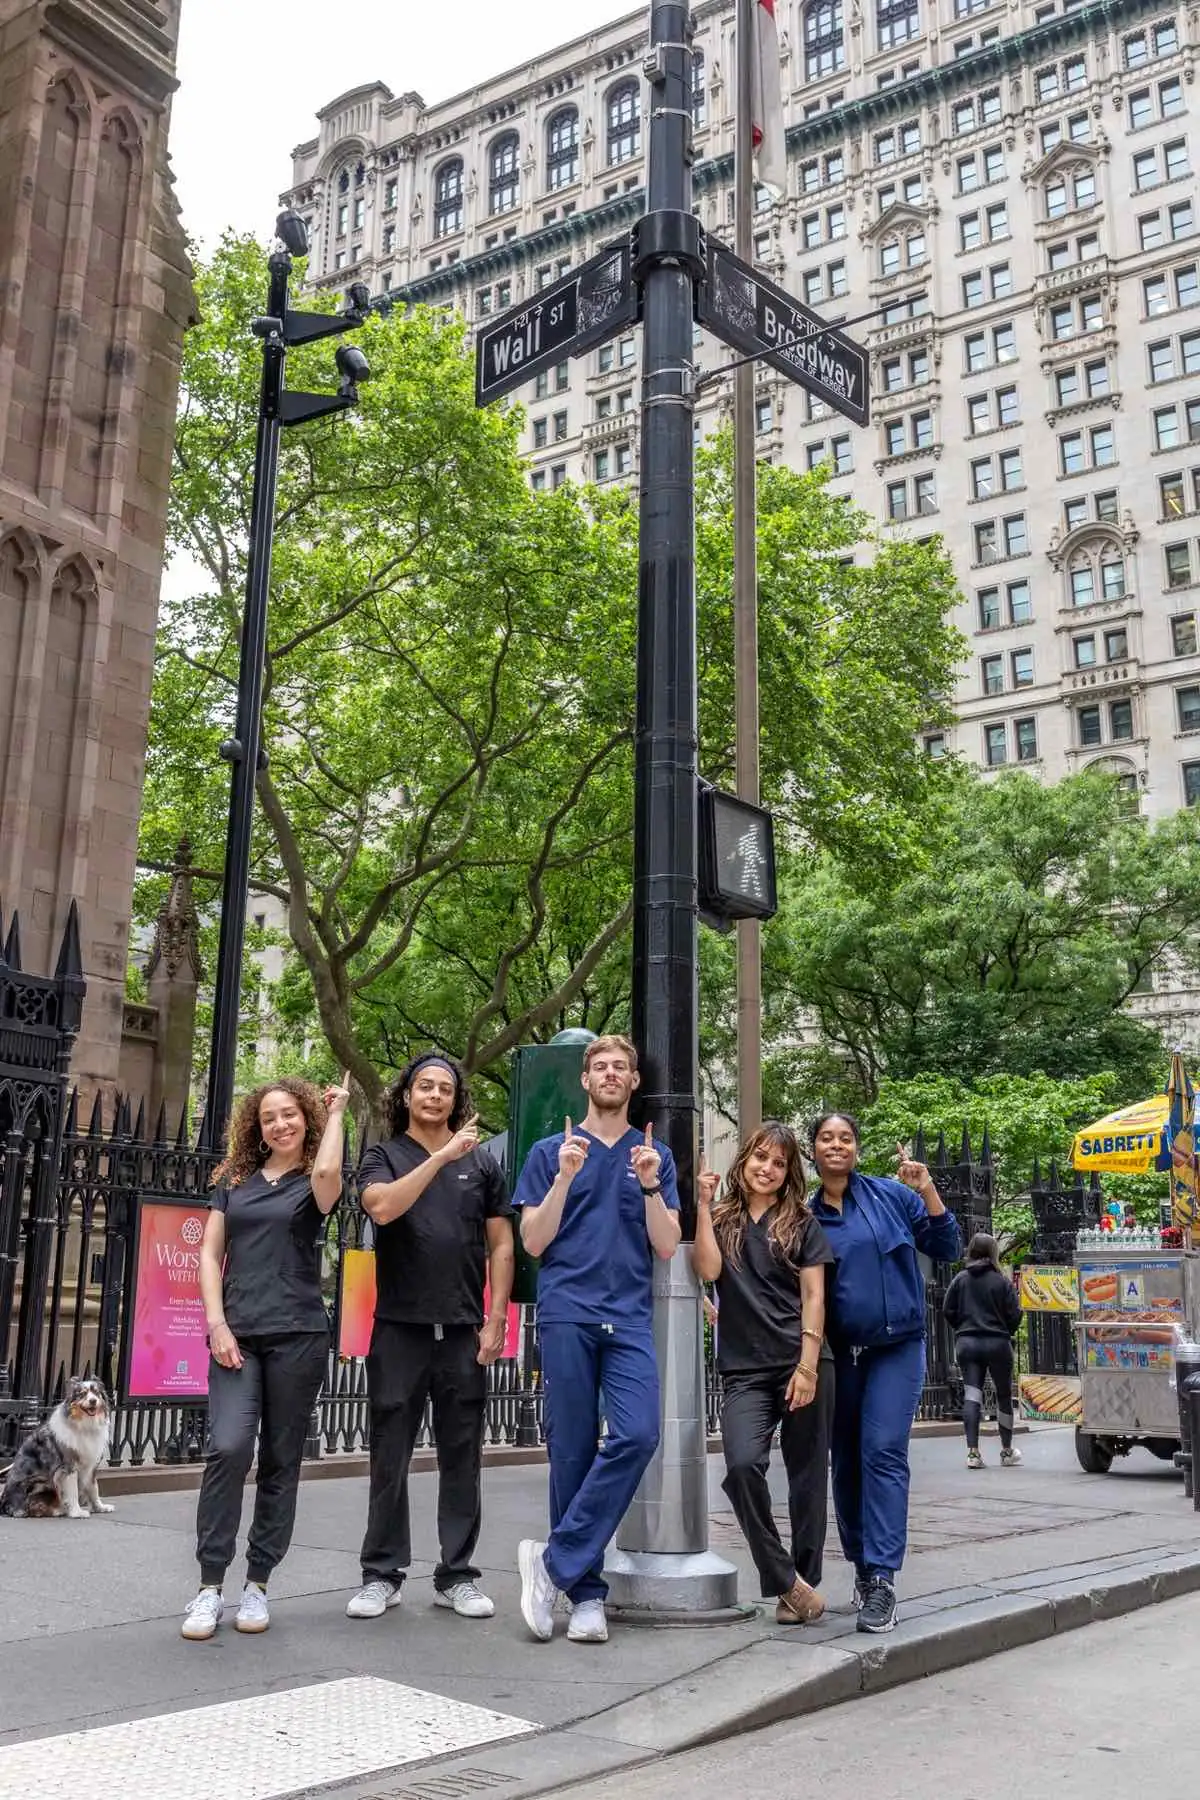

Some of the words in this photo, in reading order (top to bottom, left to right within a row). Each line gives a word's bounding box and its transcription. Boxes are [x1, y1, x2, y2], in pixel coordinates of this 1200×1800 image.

[493, 318, 541, 376] Wall
[550, 301, 566, 326] ST
[790, 309, 823, 342] 75-10
[765, 306, 856, 398] Broadway
[1080, 1133, 1154, 1156] SABRETT
[156, 1243, 200, 1269] Wors
[1127, 1281, 1138, 1296] A
